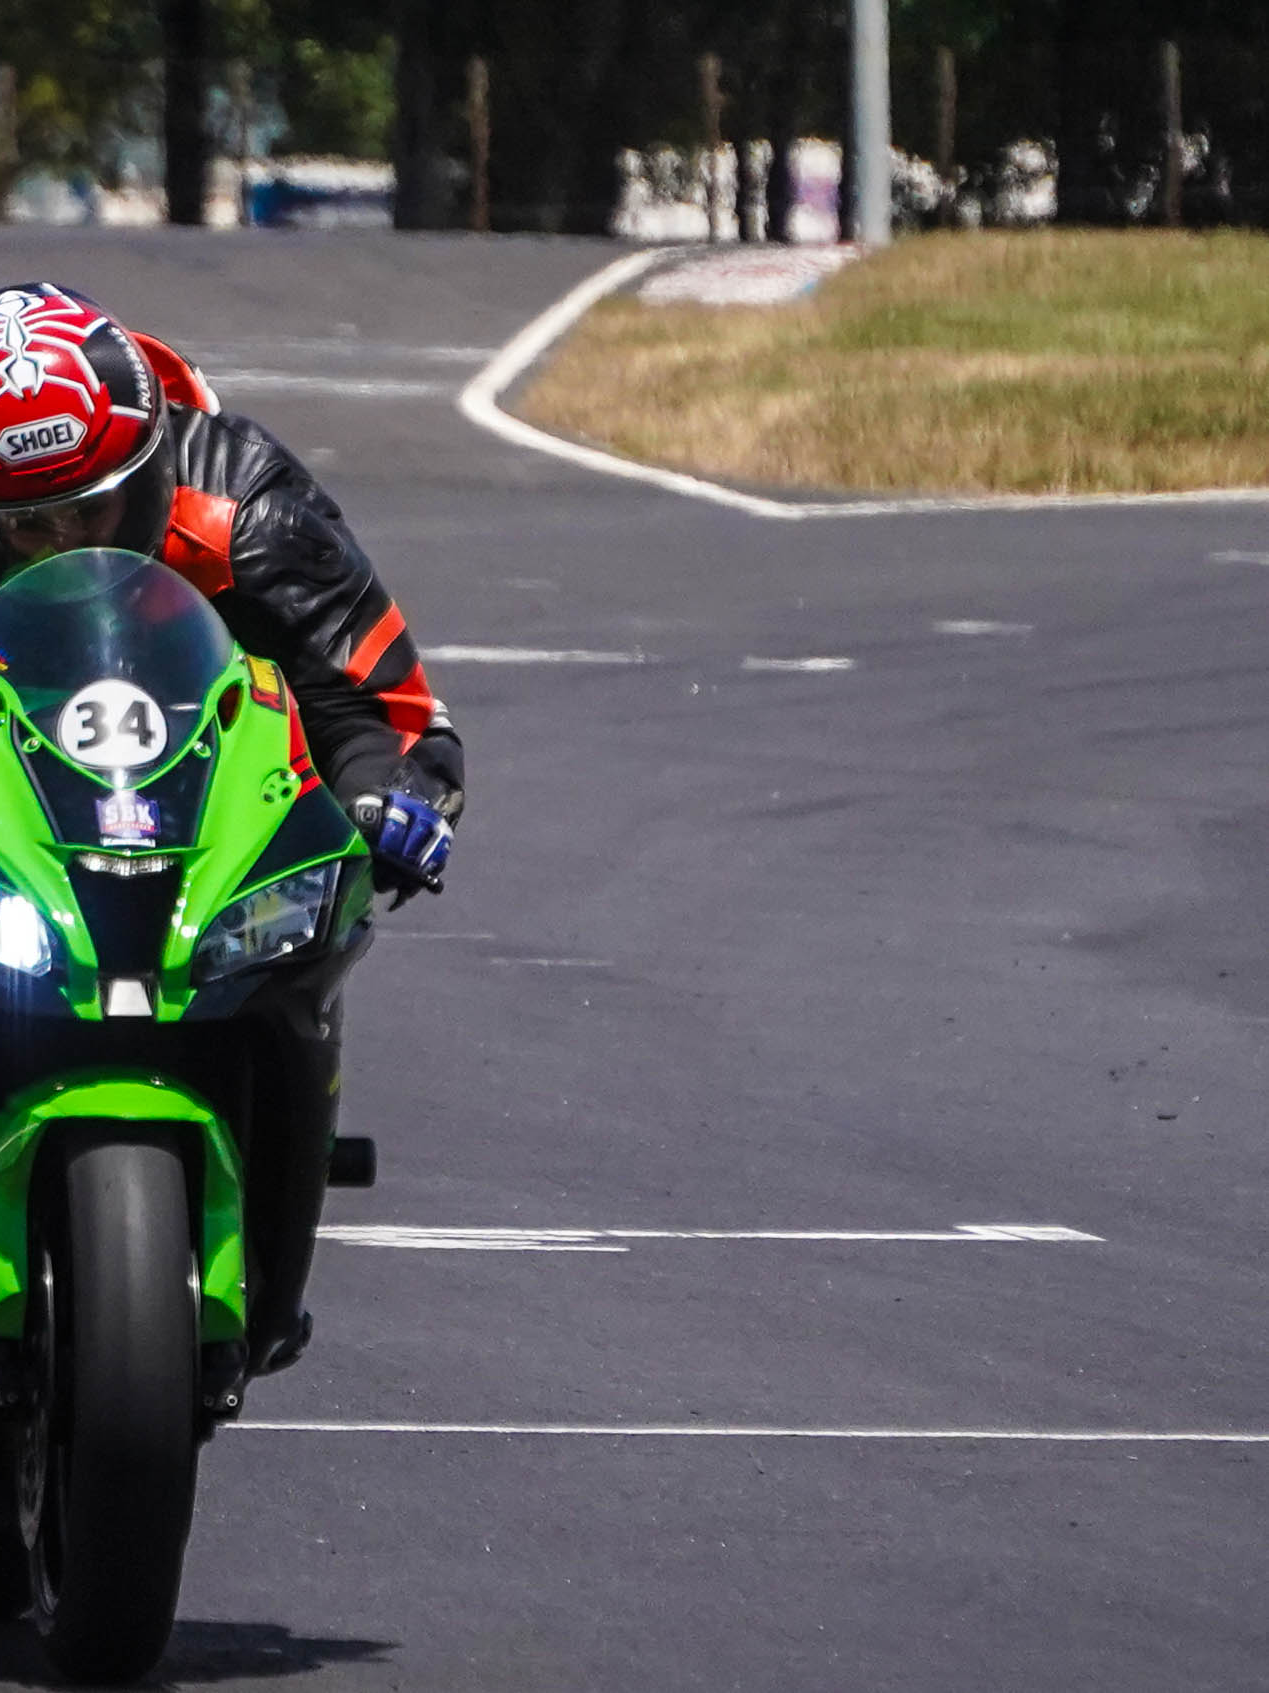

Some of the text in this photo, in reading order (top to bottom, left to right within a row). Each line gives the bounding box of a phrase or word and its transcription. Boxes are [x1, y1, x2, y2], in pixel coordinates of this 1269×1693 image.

[6, 421, 74, 456] SHOEI
[75, 700, 156, 751] 34
[104, 804, 155, 825] SBK
